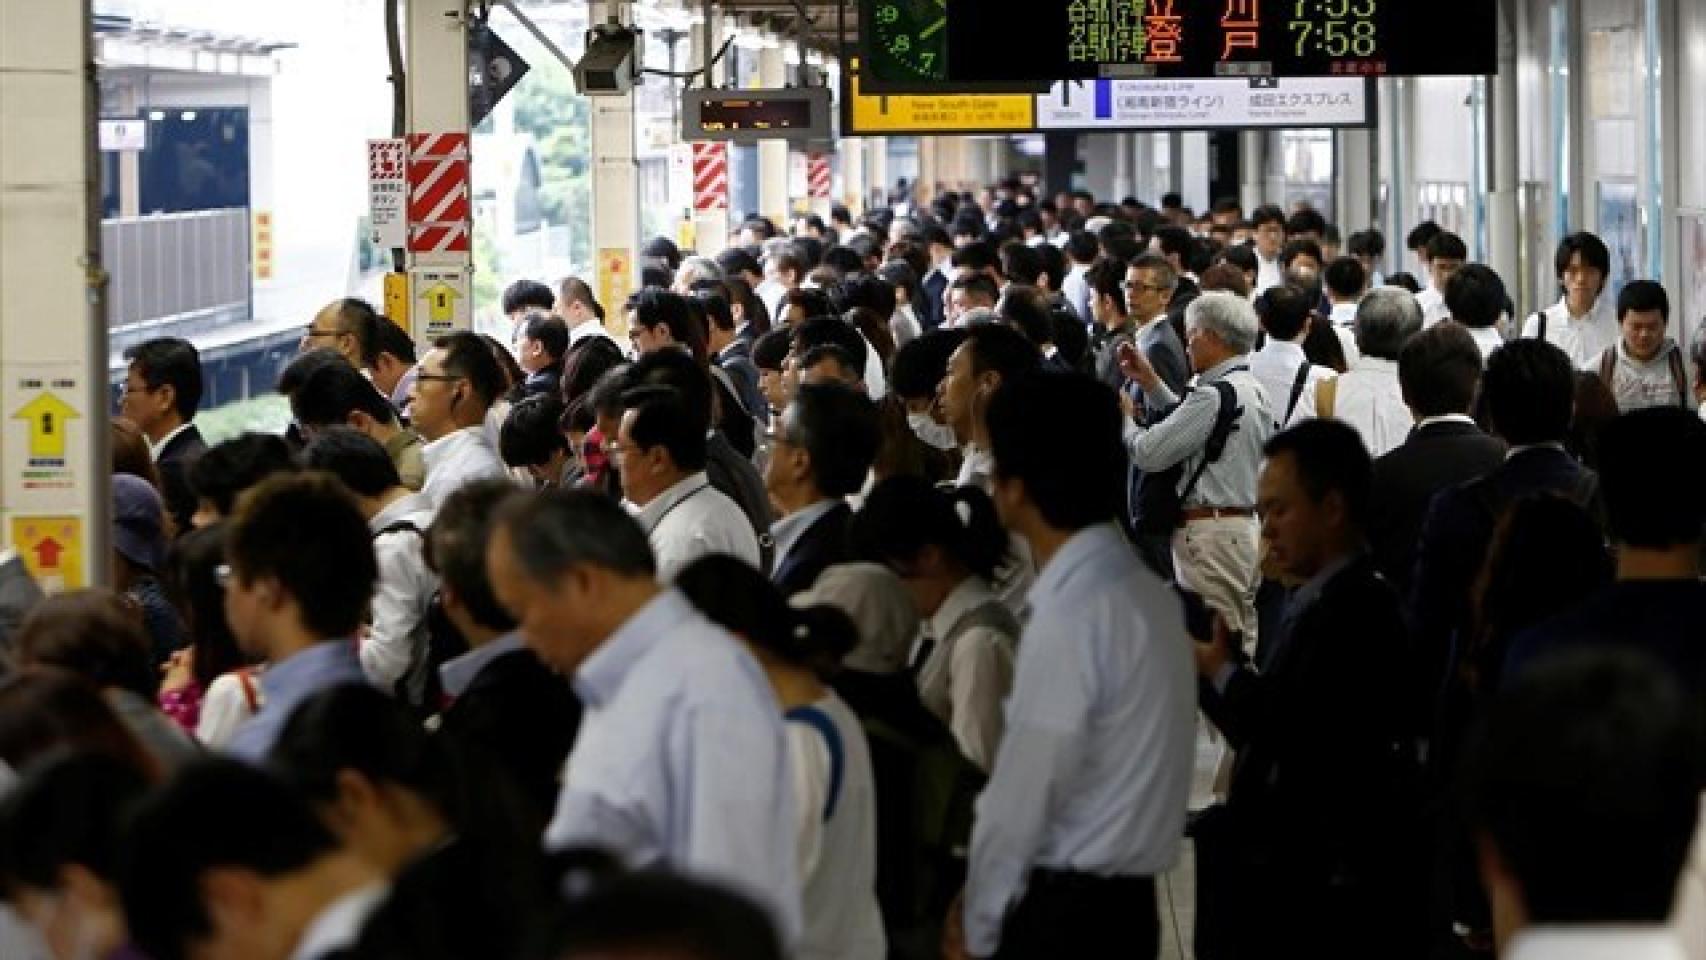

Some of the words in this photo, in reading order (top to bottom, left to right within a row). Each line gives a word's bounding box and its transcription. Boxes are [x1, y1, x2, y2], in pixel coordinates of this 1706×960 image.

[895, 34, 909, 51] 8
[1289, 21, 1376, 56] 7:58
[919, 53, 936, 74] 7
